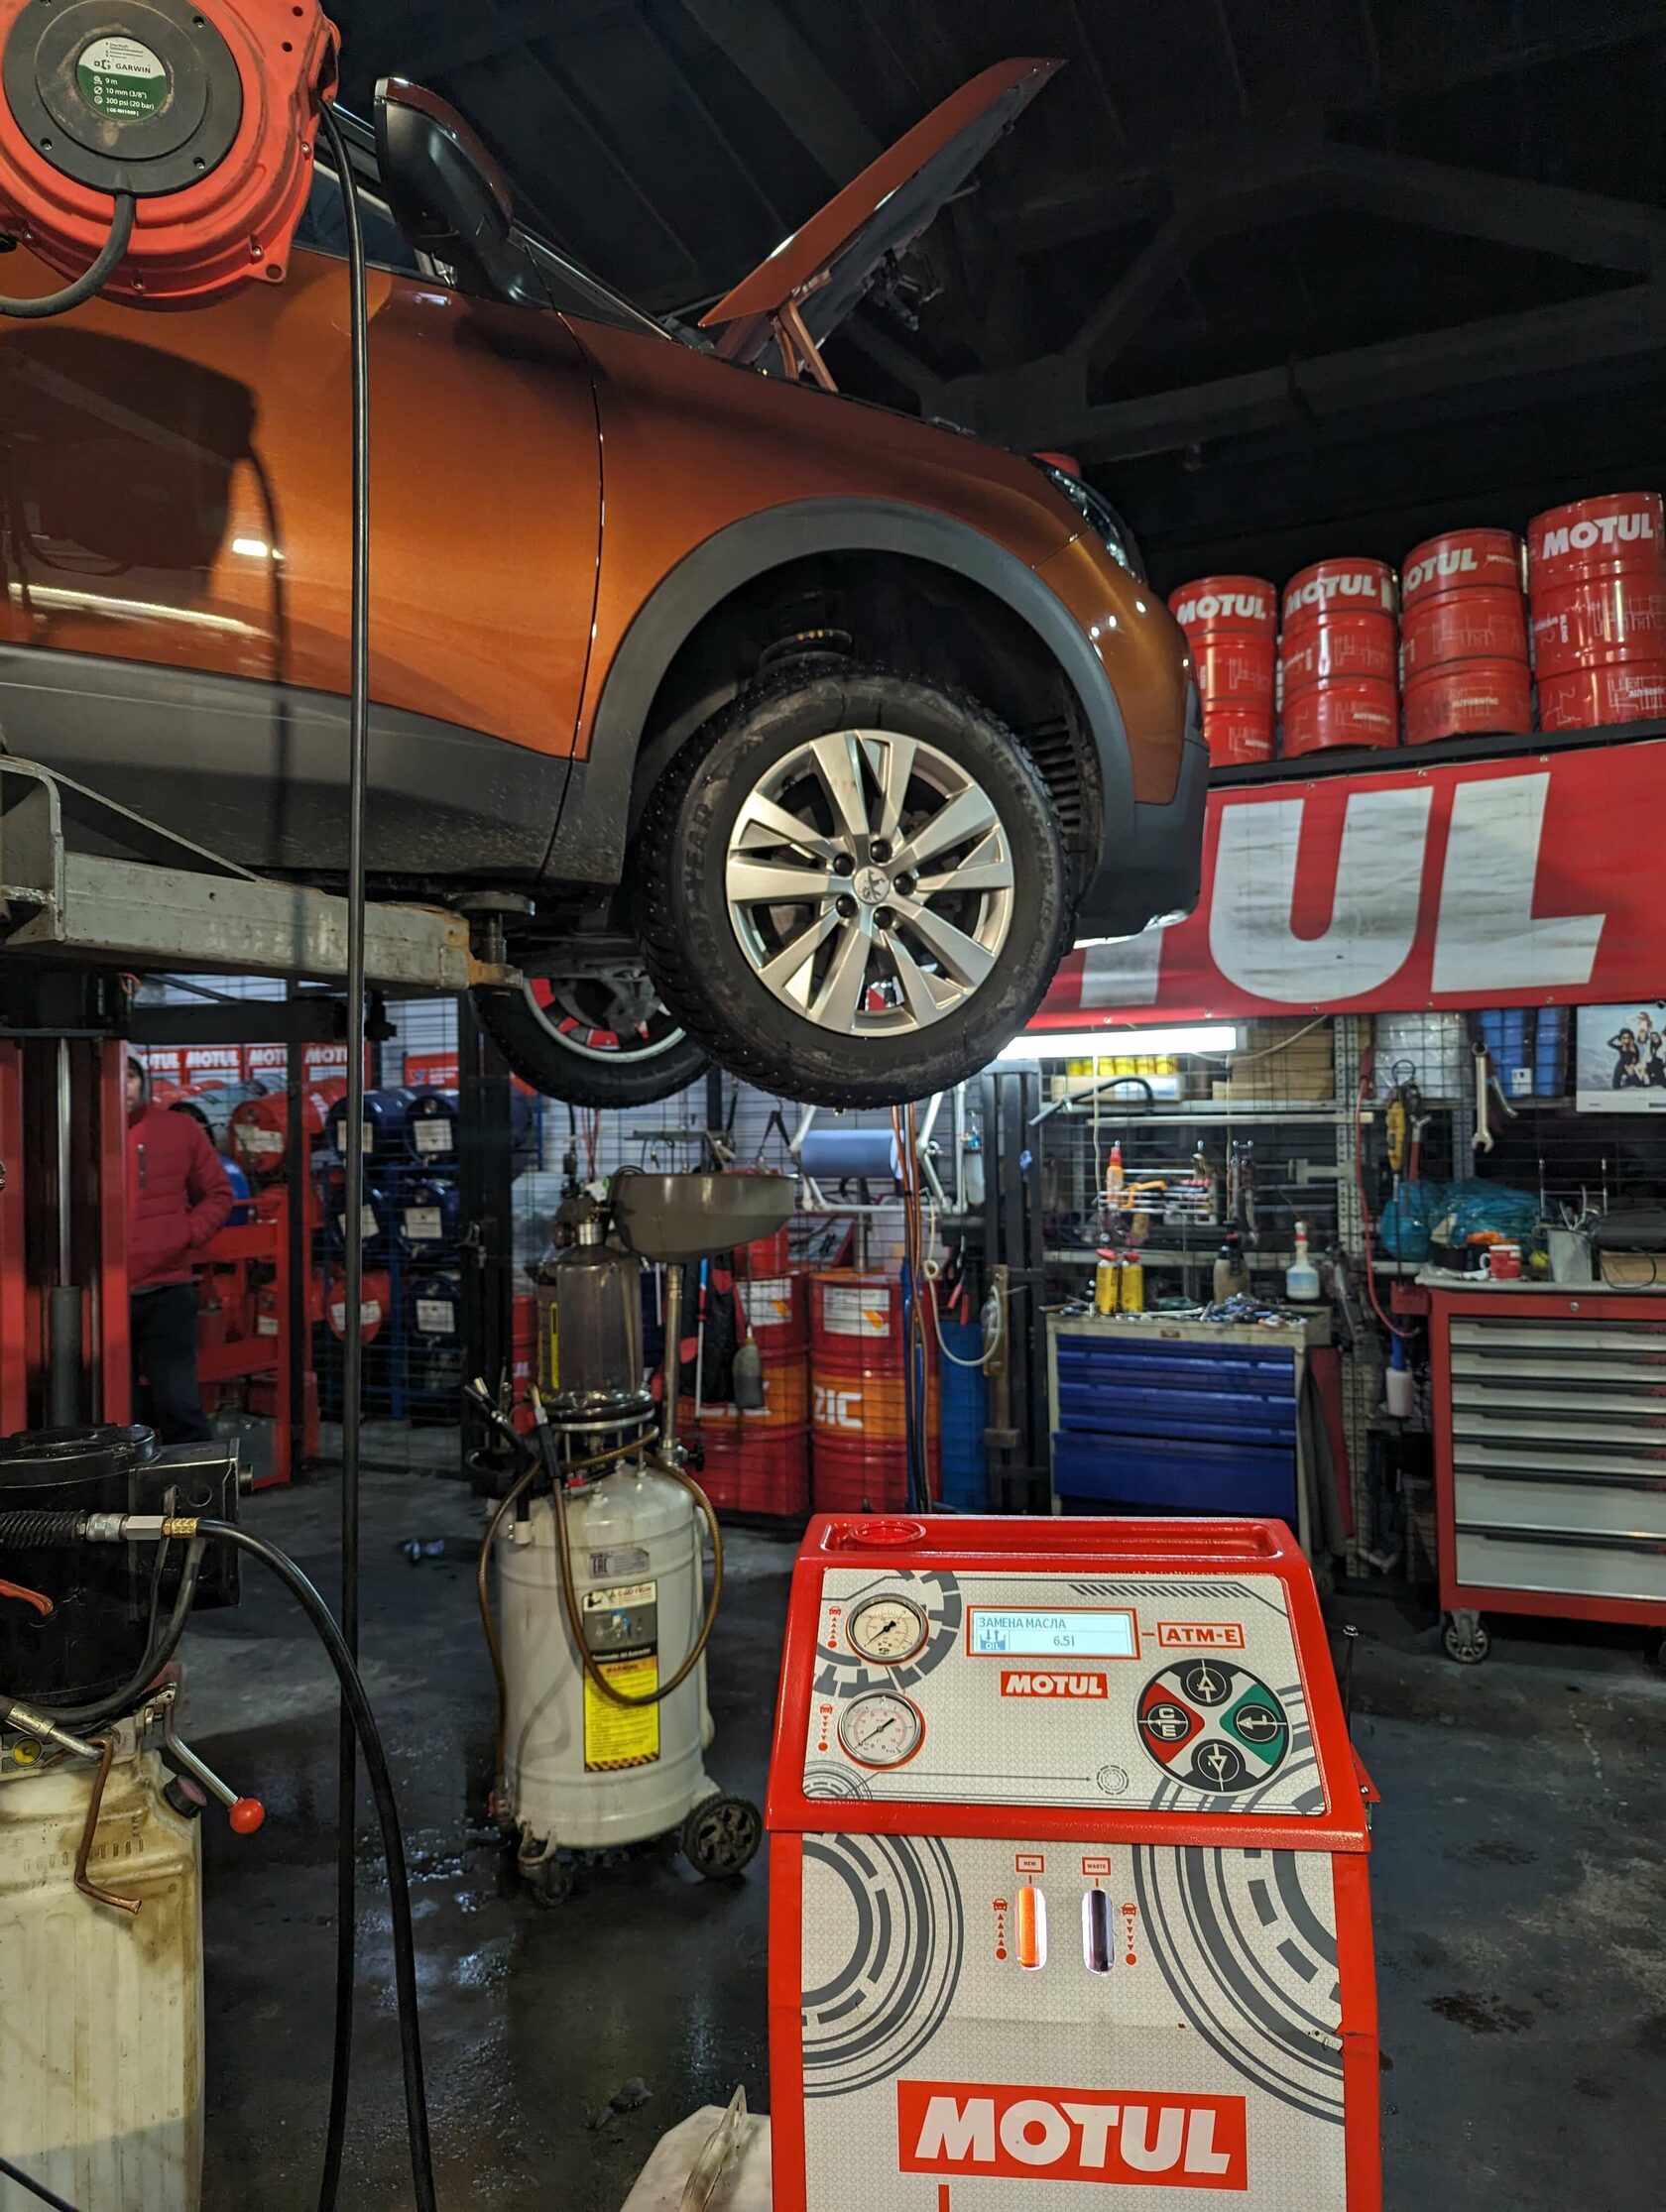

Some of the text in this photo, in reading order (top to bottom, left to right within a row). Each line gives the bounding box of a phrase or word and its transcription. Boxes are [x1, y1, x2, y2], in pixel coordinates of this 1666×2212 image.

[115, 62, 151, 74] GARWIN
[129, 100, 140, 109] (20
[141, 102, 155, 111] bar)
[1542, 513, 1654, 560] MOTUL
[1285, 574, 1376, 620] MOTUL
[1176, 594, 1267, 626] MOTUL
[186, 1048, 240, 1068] MOTUL
[249, 1047, 288, 1066] MOT
[304, 1045, 348, 1065] MOT
[978, 1616, 1067, 1630] ЗАМЕНА МАСЛА
[1164, 1627, 1239, 1644] ATM-E
[1005, 1673, 1104, 1696] MOTUL
[913, 2095, 1232, 2175] MOTUL
